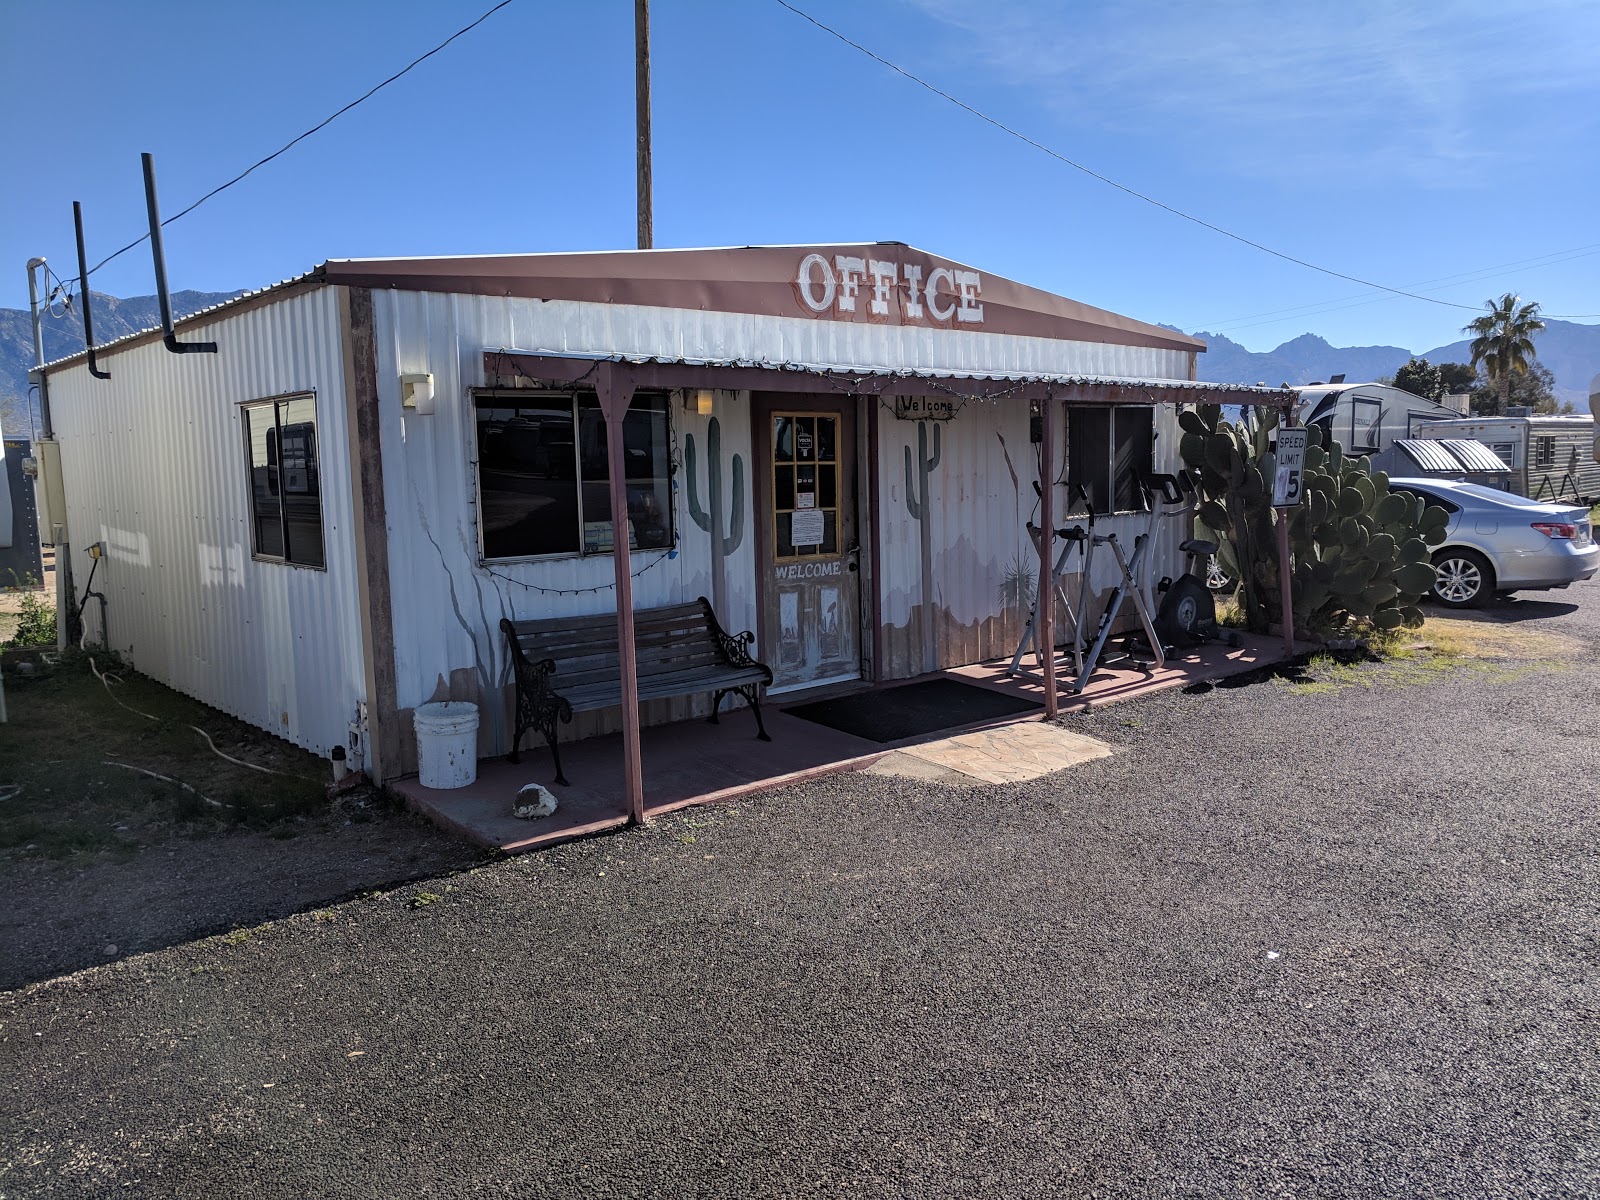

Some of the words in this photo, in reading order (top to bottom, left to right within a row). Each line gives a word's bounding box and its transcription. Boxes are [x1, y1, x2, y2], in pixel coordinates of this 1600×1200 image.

[798, 253, 984, 324] OFFICE
[901, 395, 953, 411] Welcome
[1279, 437, 1304, 448] SPEED
[1280, 454, 1300, 465] LIMIT
[775, 561, 841, 579] WELCOME
